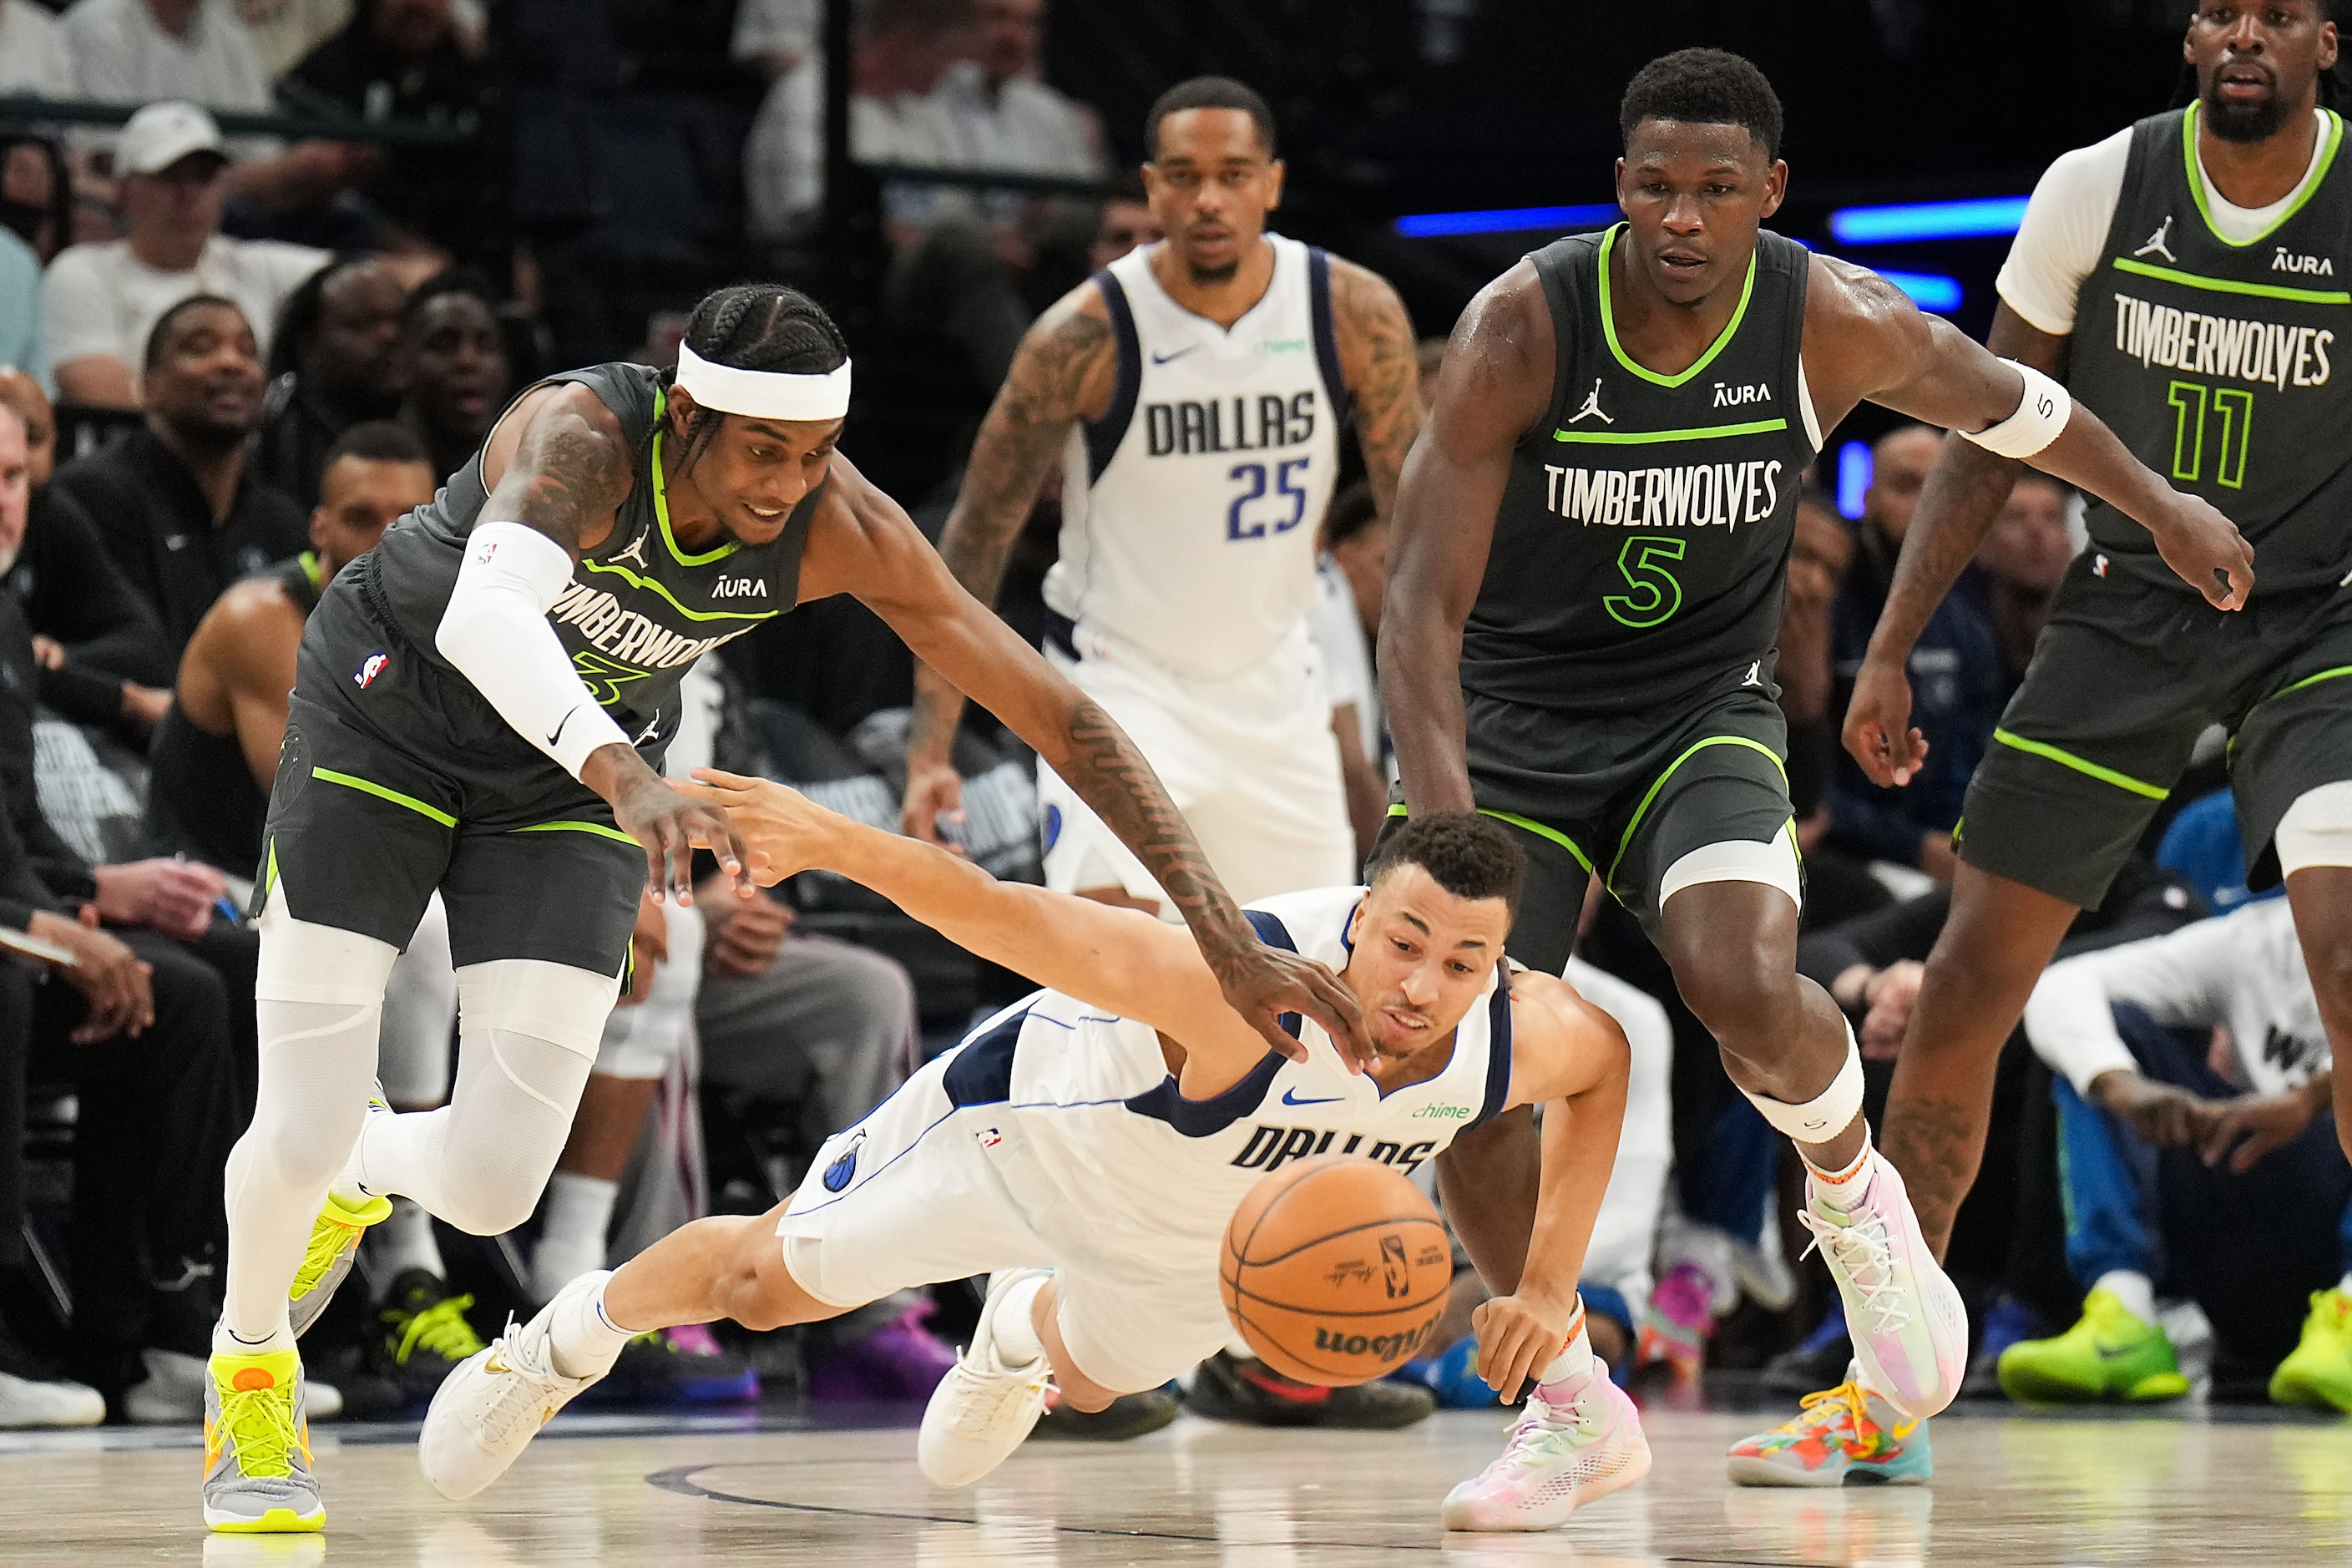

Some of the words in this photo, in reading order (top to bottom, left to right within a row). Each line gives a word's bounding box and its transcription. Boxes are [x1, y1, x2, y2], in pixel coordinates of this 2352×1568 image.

[2114, 292, 2334, 393] TIMBERWOLVES
[1146, 390, 1315, 458] DALLAS
[2168, 379, 2253, 490] 11
[1227, 458, 1309, 541] 25
[1545, 460, 1782, 534] TIMBERWOLVES
[1603, 536, 1686, 627] 5
[1411, 1101, 1470, 1120] chime
